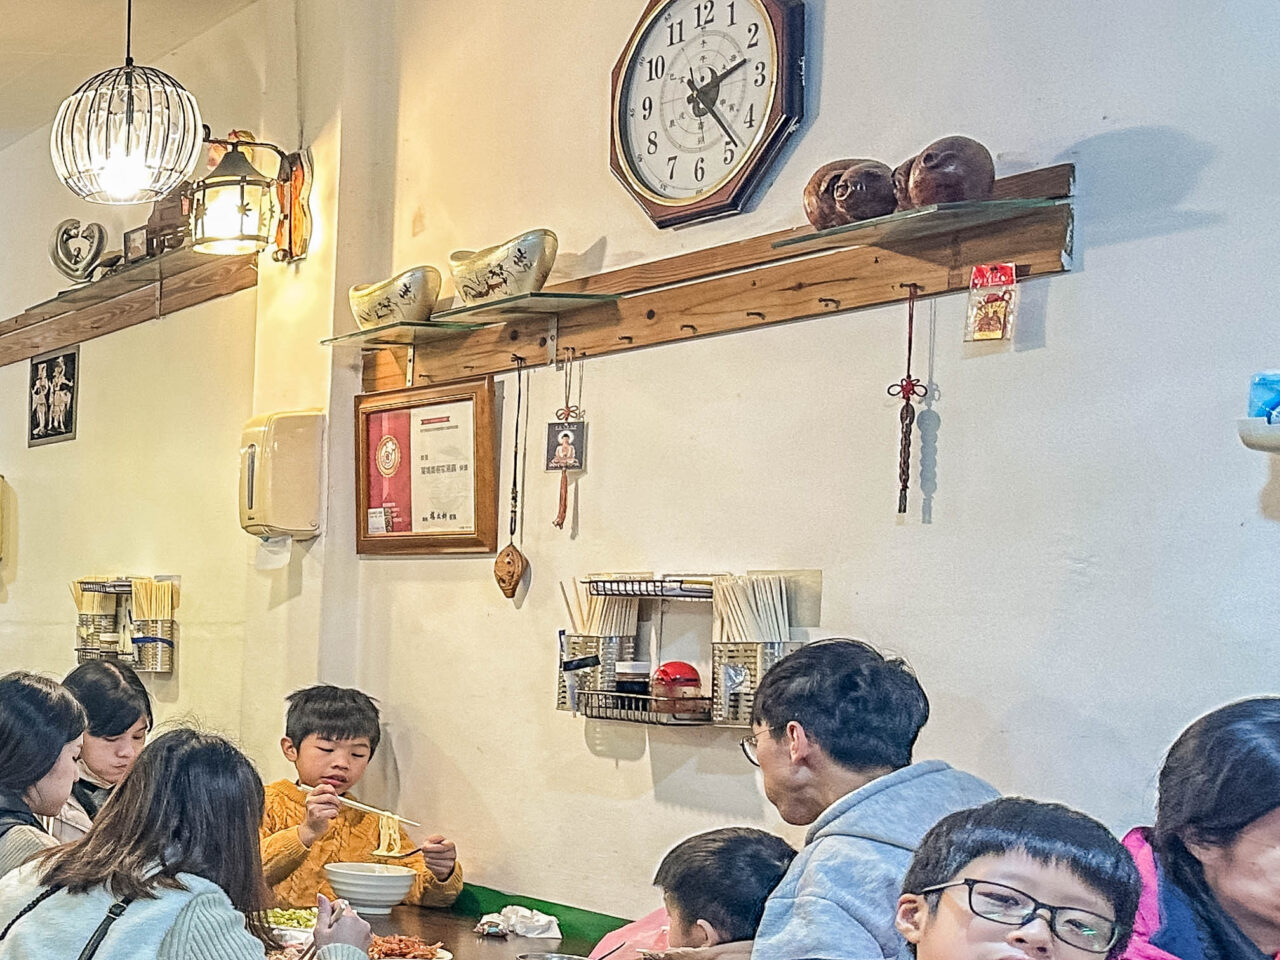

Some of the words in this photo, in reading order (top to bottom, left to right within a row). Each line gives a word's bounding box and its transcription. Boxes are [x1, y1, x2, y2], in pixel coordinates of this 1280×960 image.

[694, 0, 715, 29] 12
[727, 1, 737, 27] 1
[666, 18, 686, 47] 11
[747, 22, 759, 49] 2
[646, 55, 665, 82] 10
[754, 61, 766, 87] 3
[642, 96, 653, 120] 9
[743, 103, 755, 129] 4
[647, 131, 658, 155] 8
[723, 141, 735, 165] 5
[667, 155, 678, 180] 7
[694, 157, 705, 182] 6
